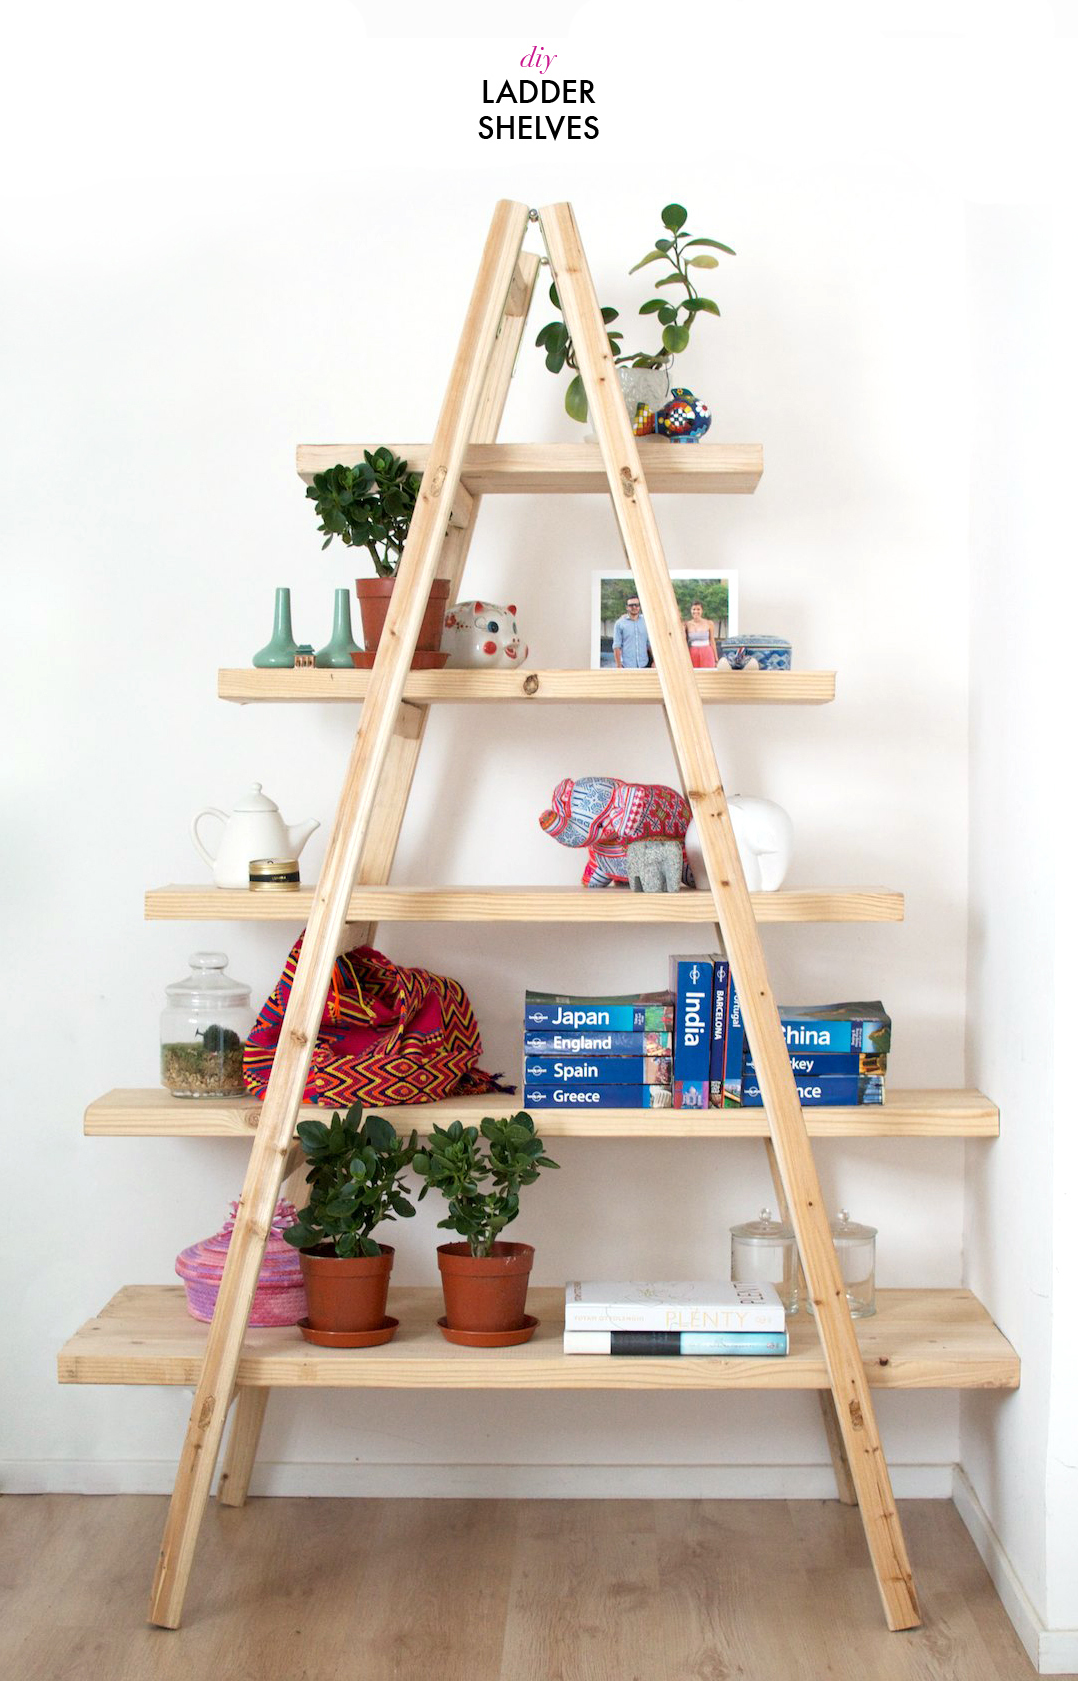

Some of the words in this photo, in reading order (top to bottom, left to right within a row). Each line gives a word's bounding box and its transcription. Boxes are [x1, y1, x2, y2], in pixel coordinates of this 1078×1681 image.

[551, 1006, 611, 1029] Japan
[714, 990, 725, 1041] BARCELONA
[731, 990, 741, 1028] ortugal
[684, 992, 706, 1047] India
[553, 1035, 612, 1053] England
[553, 1062, 599, 1081] Spain
[789, 1056, 815, 1073] key
[553, 1089, 601, 1103] Greece
[796, 1086, 822, 1099] nce
